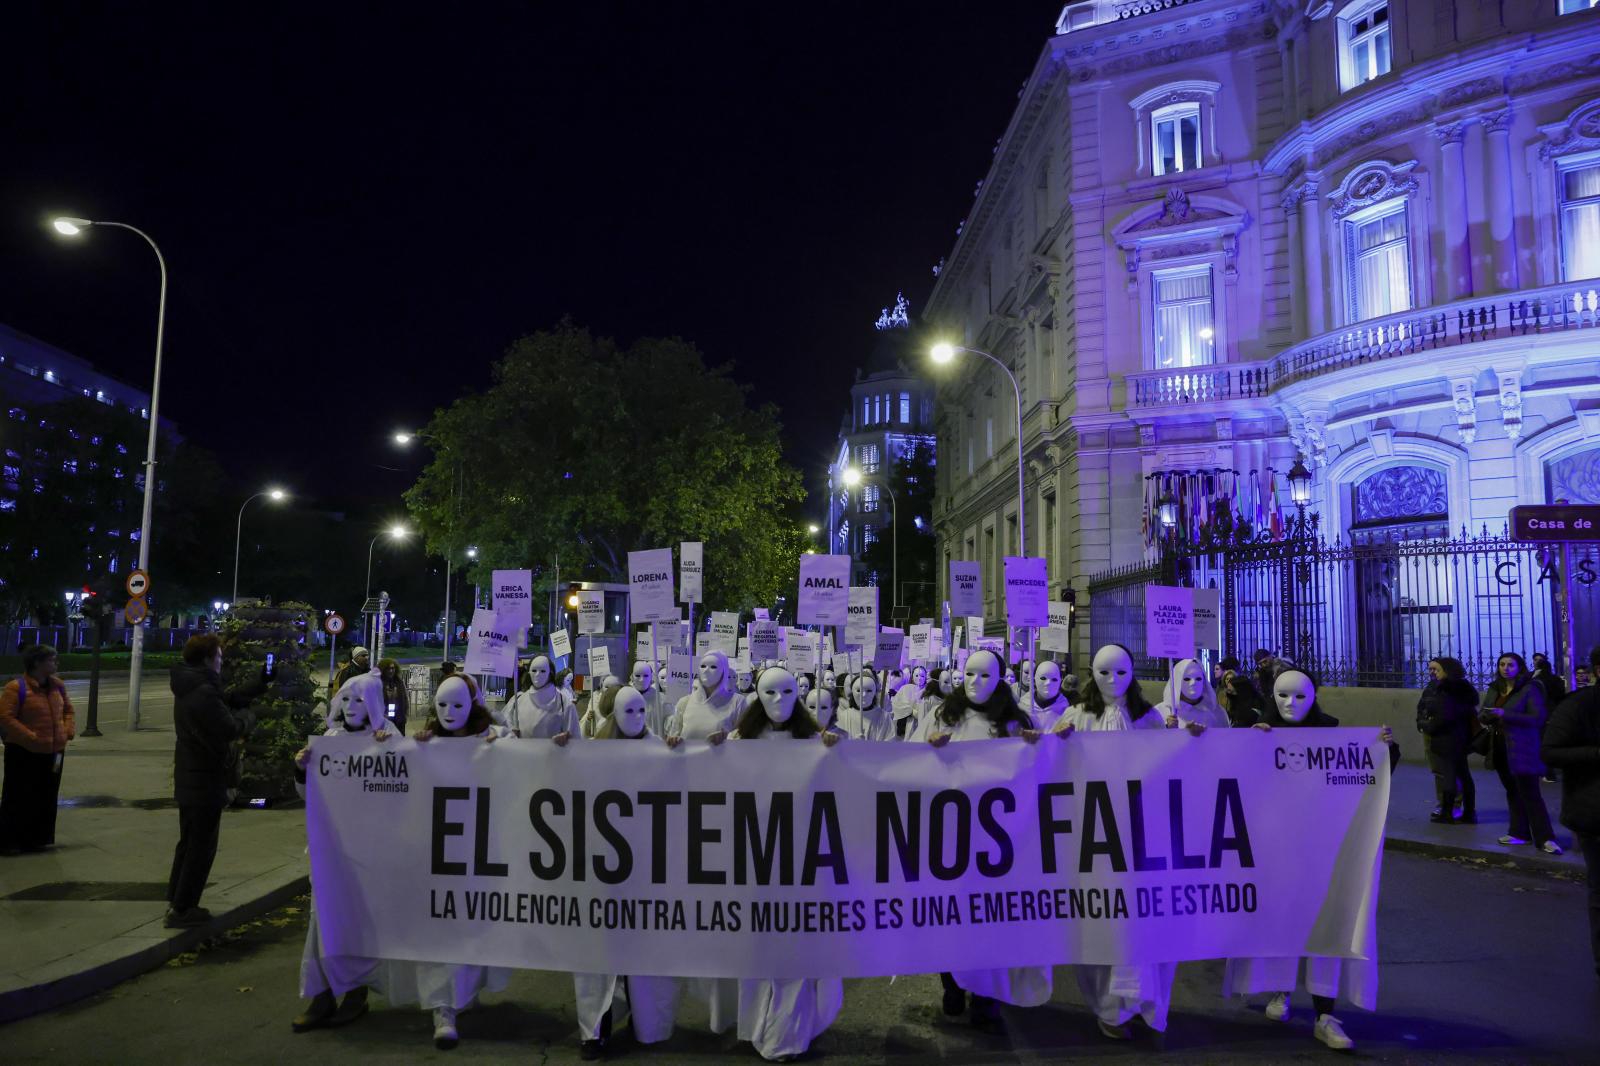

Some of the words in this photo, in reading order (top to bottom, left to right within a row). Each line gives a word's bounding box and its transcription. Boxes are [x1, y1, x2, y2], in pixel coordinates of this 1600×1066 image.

[1528, 518, 1565, 529] Casa
[1573, 518, 1592, 529] de
[632, 572, 668, 584] LORENA
[804, 577, 843, 589] AMAL
[955, 574, 977, 582] SUZAN
[1008, 578, 1046, 587] MERCEDES
[848, 606, 865, 614] NOA
[866, 606, 873, 614] B
[1158, 604, 1182, 612] LAURA
[478, 630, 509, 643] LAURA
[1326, 772, 1376, 785] Feminista
[363, 779, 409, 793] Feminista
[431, 786, 508, 877] EL
[529, 788, 849, 886] SISTEMA
[875, 787, 1016, 883] NOS
[1037, 778, 1255, 874] FALLA
[430, 889, 457, 919] LA
[464, 891, 581, 927] VIOLENCIA
[589, 896, 686, 930] CONTRA
[695, 901, 741, 932] LAS
[751, 898, 866, 934] MUJERES
[875, 897, 904, 930] ES
[911, 895, 961, 927] UNA
[969, 888, 1129, 924] EMERGENCIA
[1136, 886, 1165, 918] DE
[1172, 882, 1257, 916] ESTADO
